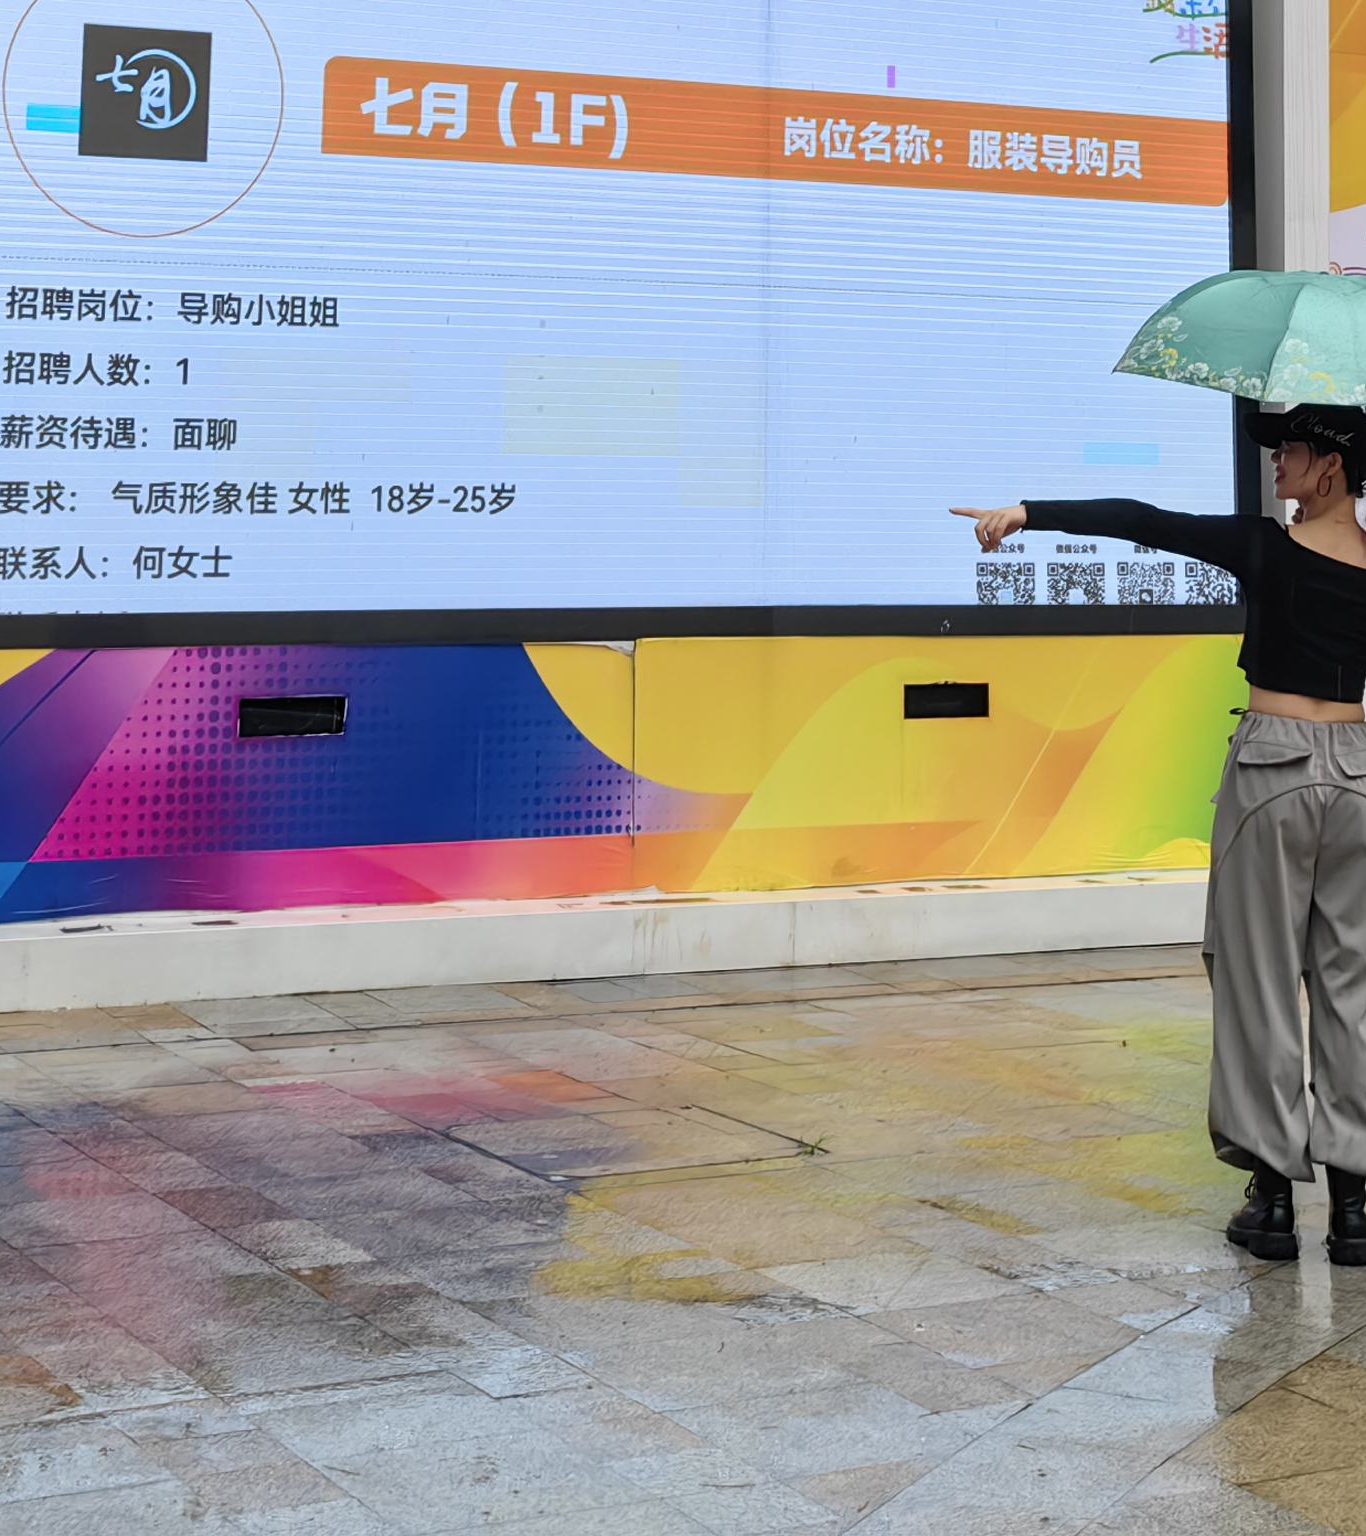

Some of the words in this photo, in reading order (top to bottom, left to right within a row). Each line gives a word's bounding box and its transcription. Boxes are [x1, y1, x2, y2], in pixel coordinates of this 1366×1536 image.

[783, 116, 1143, 180] 岗位名称：服装导购员
[5, 286, 340, 328] 招聘岗位：导购小姐姐
[2, 350, 191, 387] 招聘人数：1
[0, 415, 238, 451] 薪资待遇：面聊
[110, 481, 278, 516] 气质形象佳
[287, 481, 351, 516] 女性
[371, 482, 518, 516] 18岁-25岁
